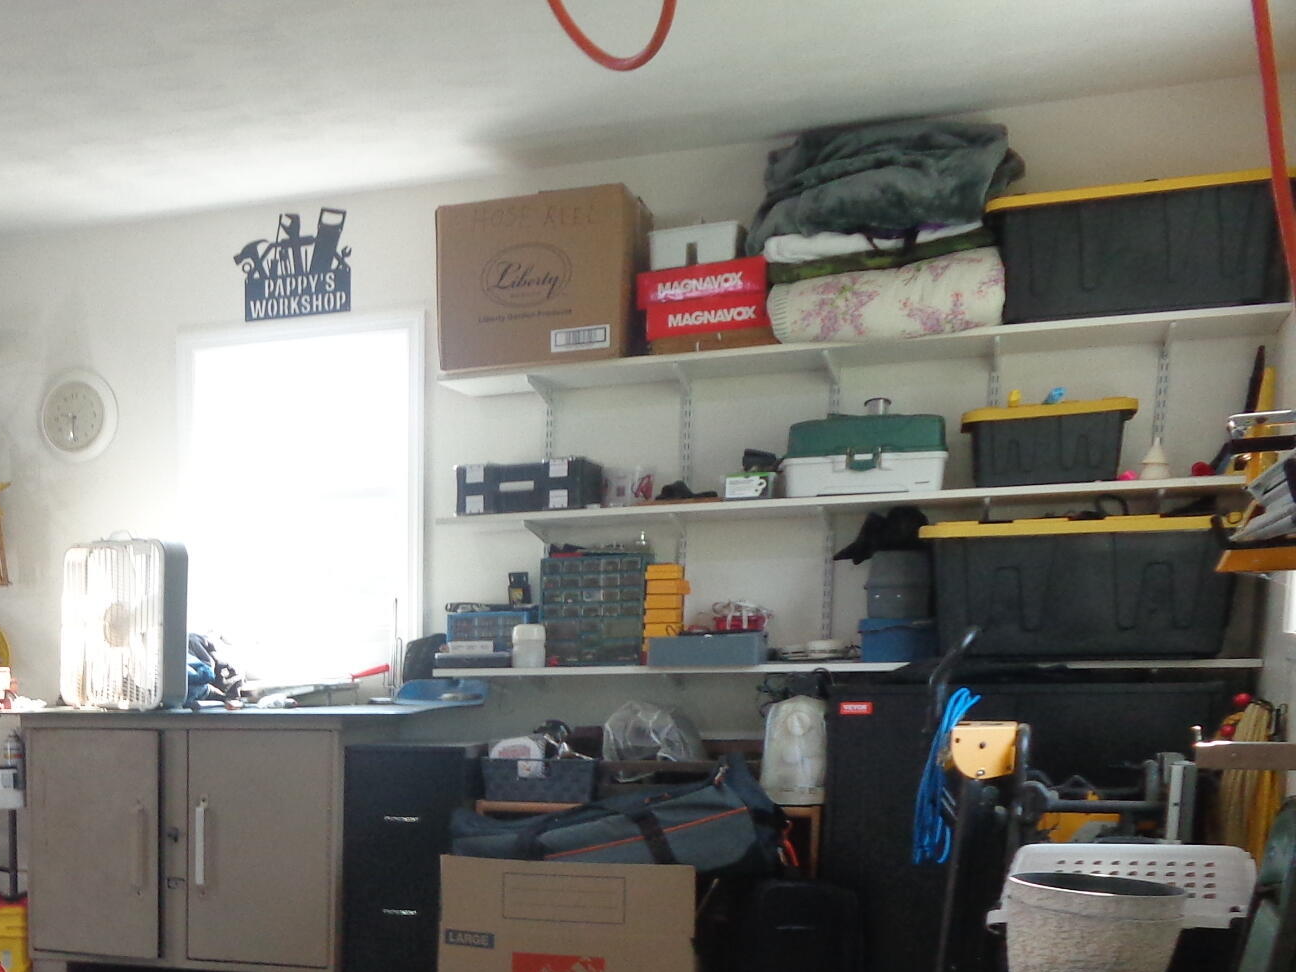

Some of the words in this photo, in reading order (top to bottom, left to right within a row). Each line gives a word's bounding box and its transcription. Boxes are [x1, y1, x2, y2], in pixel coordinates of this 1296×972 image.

[264, 271, 336, 298] PAPPY'S
[487, 261, 561, 300] Liberty
[657, 271, 743, 298] MAGNAVOX
[249, 291, 346, 319] WORKSHOP
[668, 305, 757, 328] MAGNAVOX
[448, 931, 490, 947] LARGE
